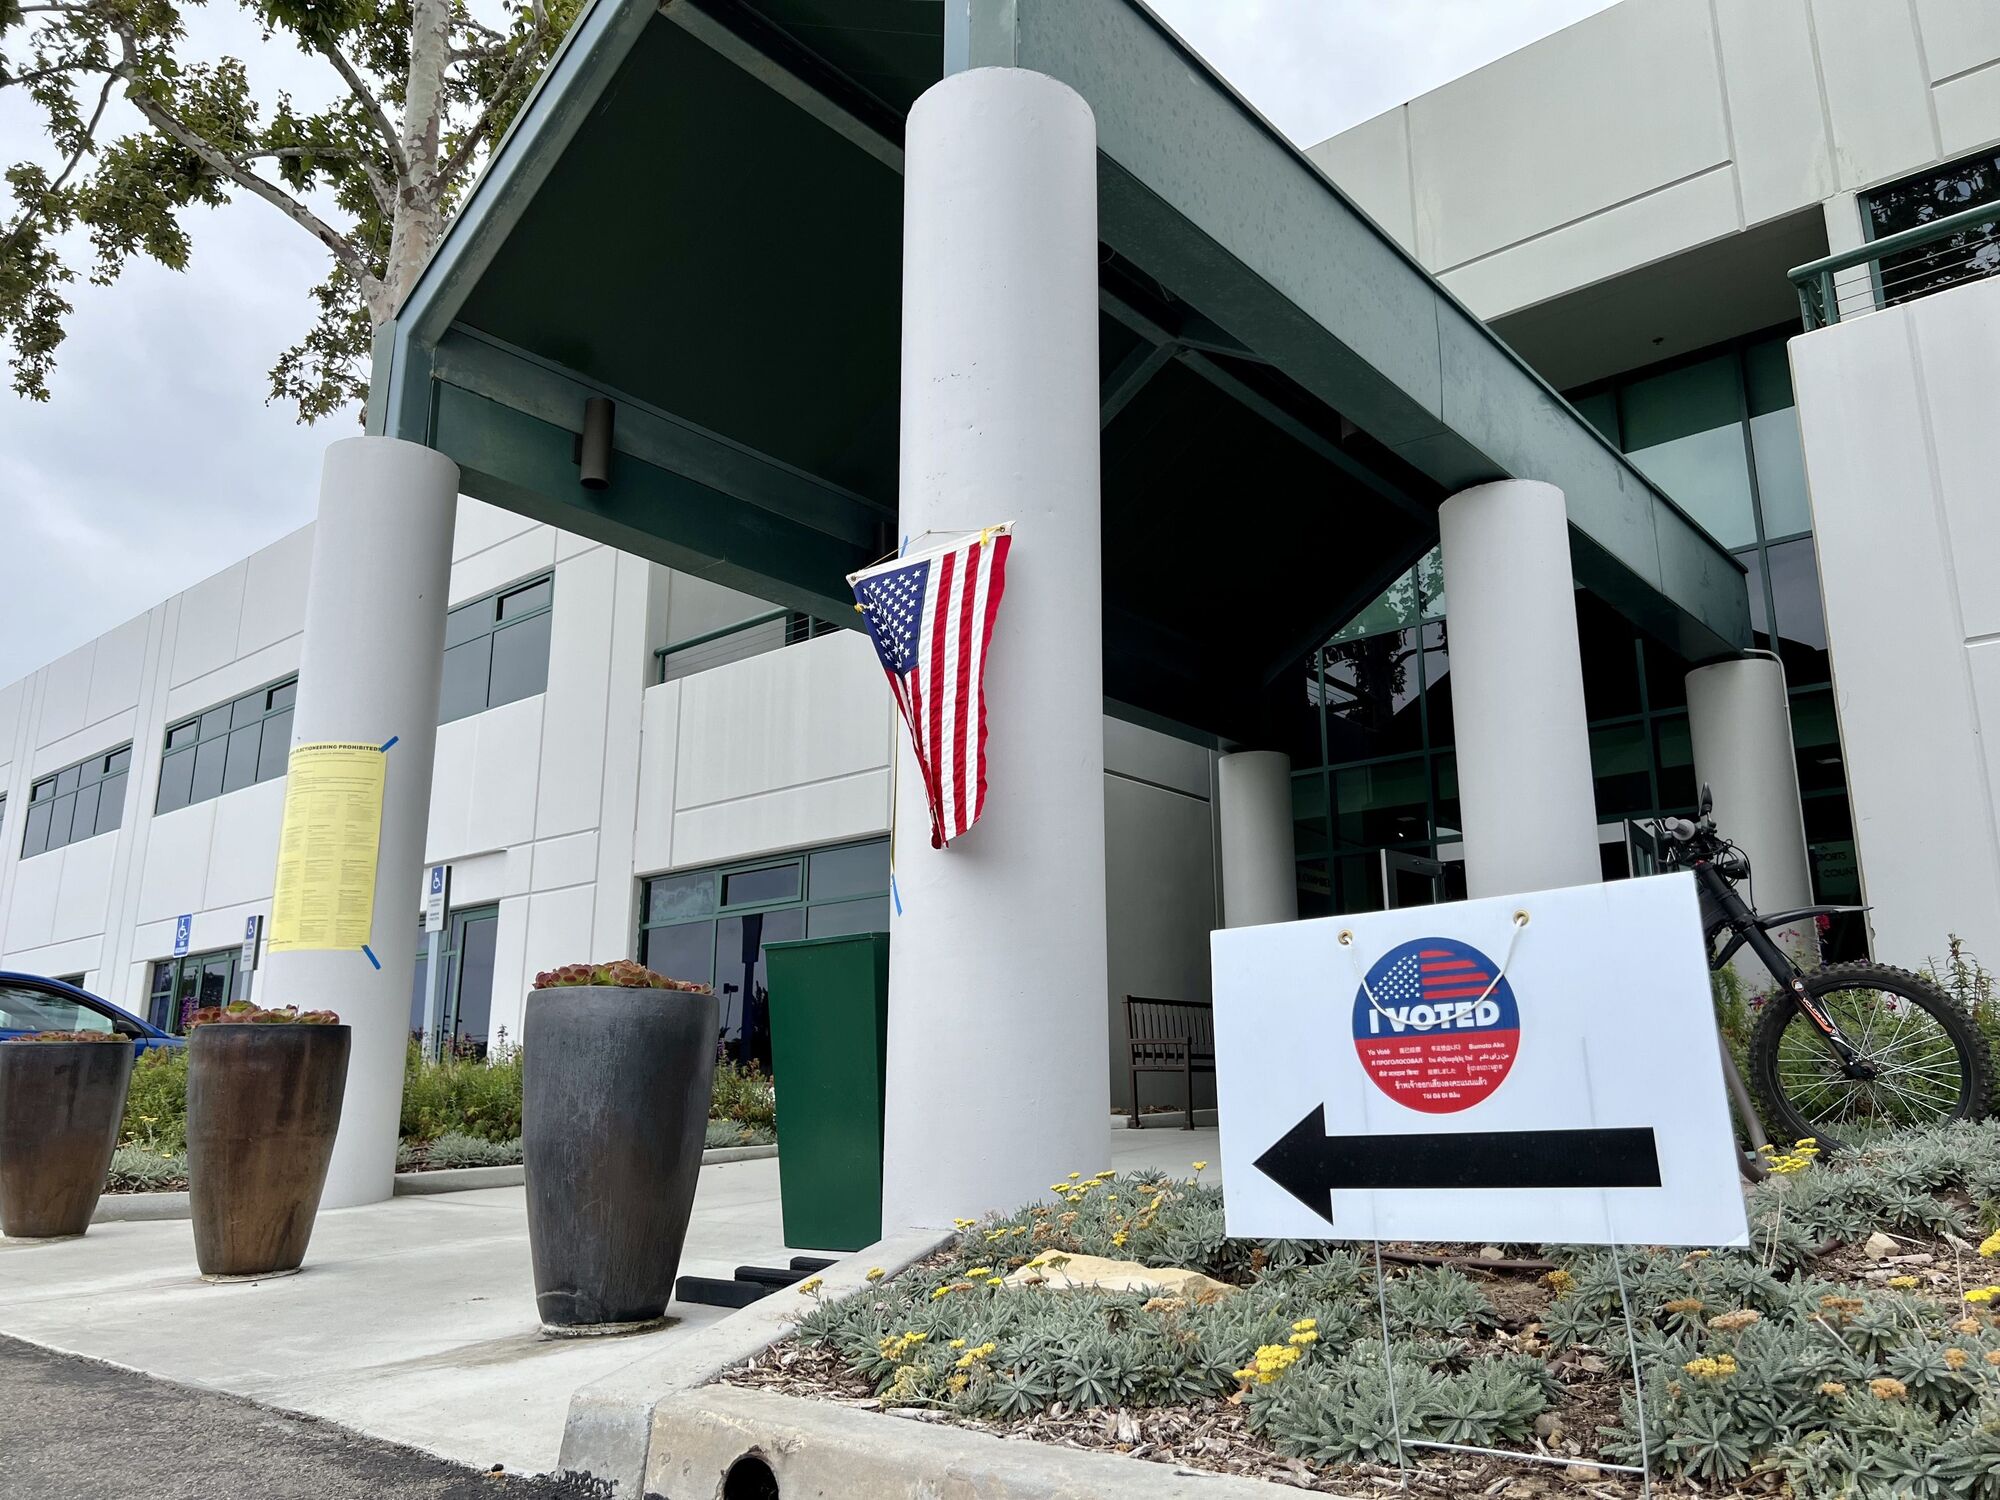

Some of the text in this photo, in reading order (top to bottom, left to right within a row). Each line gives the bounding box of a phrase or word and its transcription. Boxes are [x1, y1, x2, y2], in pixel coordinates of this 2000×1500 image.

[1368, 1000, 1500, 1034] I VOTED
[1376, 1058, 1423, 1066] ПРОГОЛОСОВАЛ
